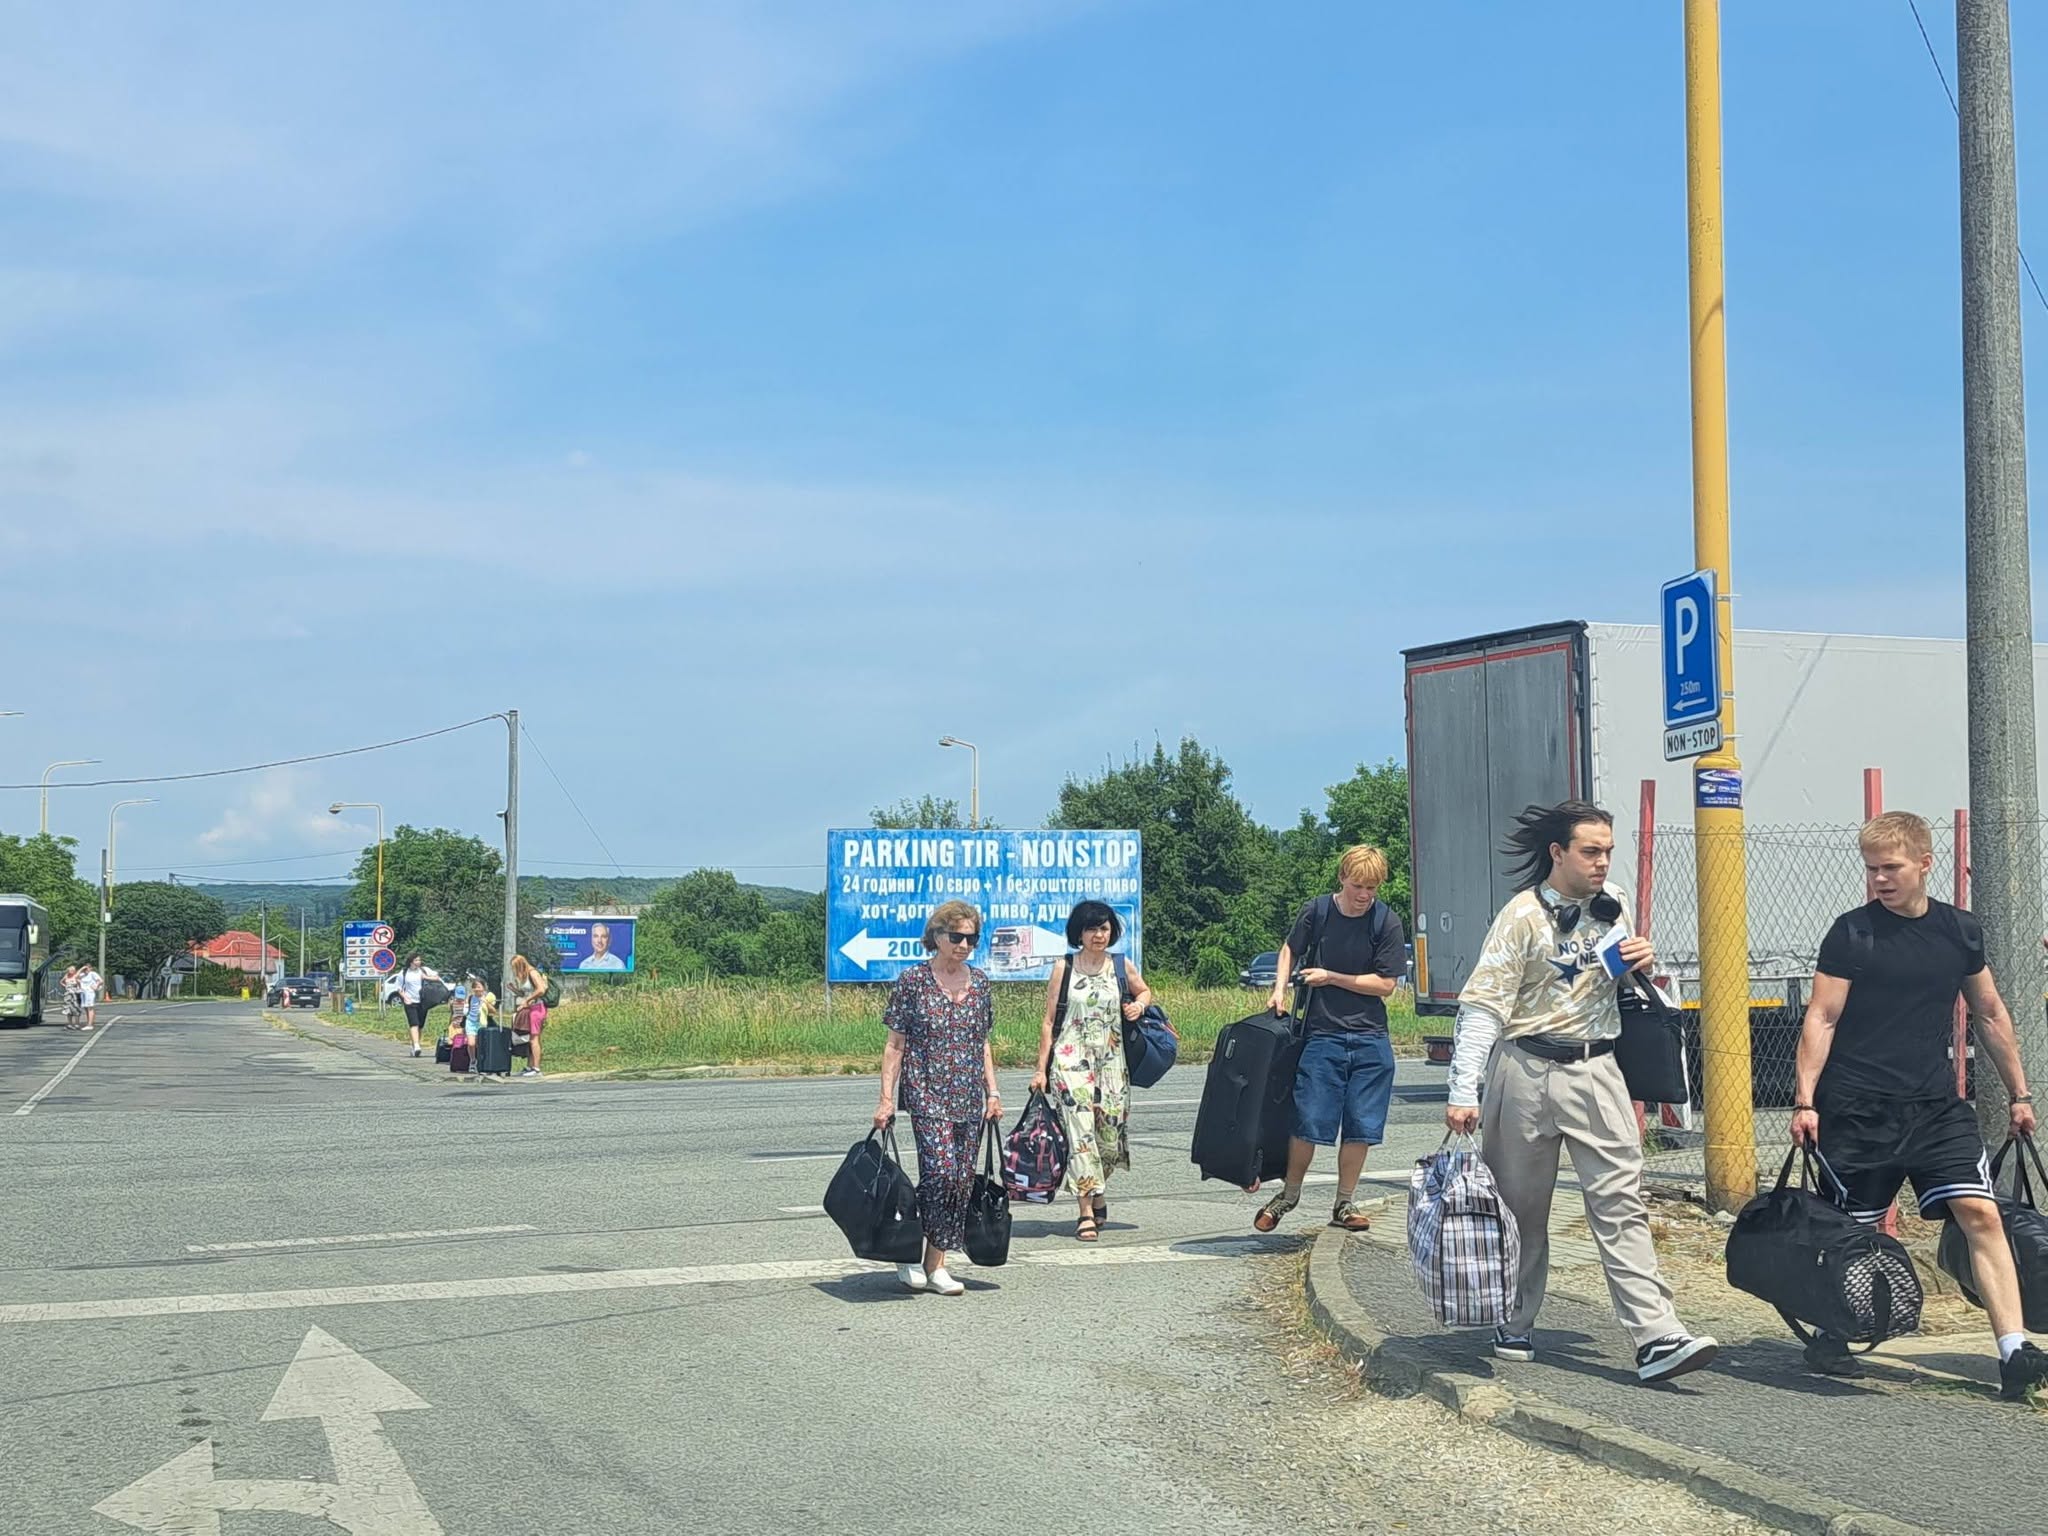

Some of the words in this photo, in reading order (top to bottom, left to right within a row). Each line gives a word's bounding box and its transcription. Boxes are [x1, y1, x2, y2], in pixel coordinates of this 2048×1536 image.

[1676, 596, 1698, 675] P
[1680, 681, 1701, 696] 250m
[1667, 726, 1716, 754] NON-STOP
[844, 838, 955, 868] PARKING
[961, 838, 1000, 868] TIR
[1022, 838, 1138, 868] NONSTOP
[842, 873, 860, 894] 24
[863, 877, 915, 897] години
[927, 873, 944, 894] 10
[996, 873, 1003, 893] 1
[1006, 873, 1101, 894] безкоштовне
[1104, 877, 1138, 893] пиво
[1558, 941, 1579, 955] NO
